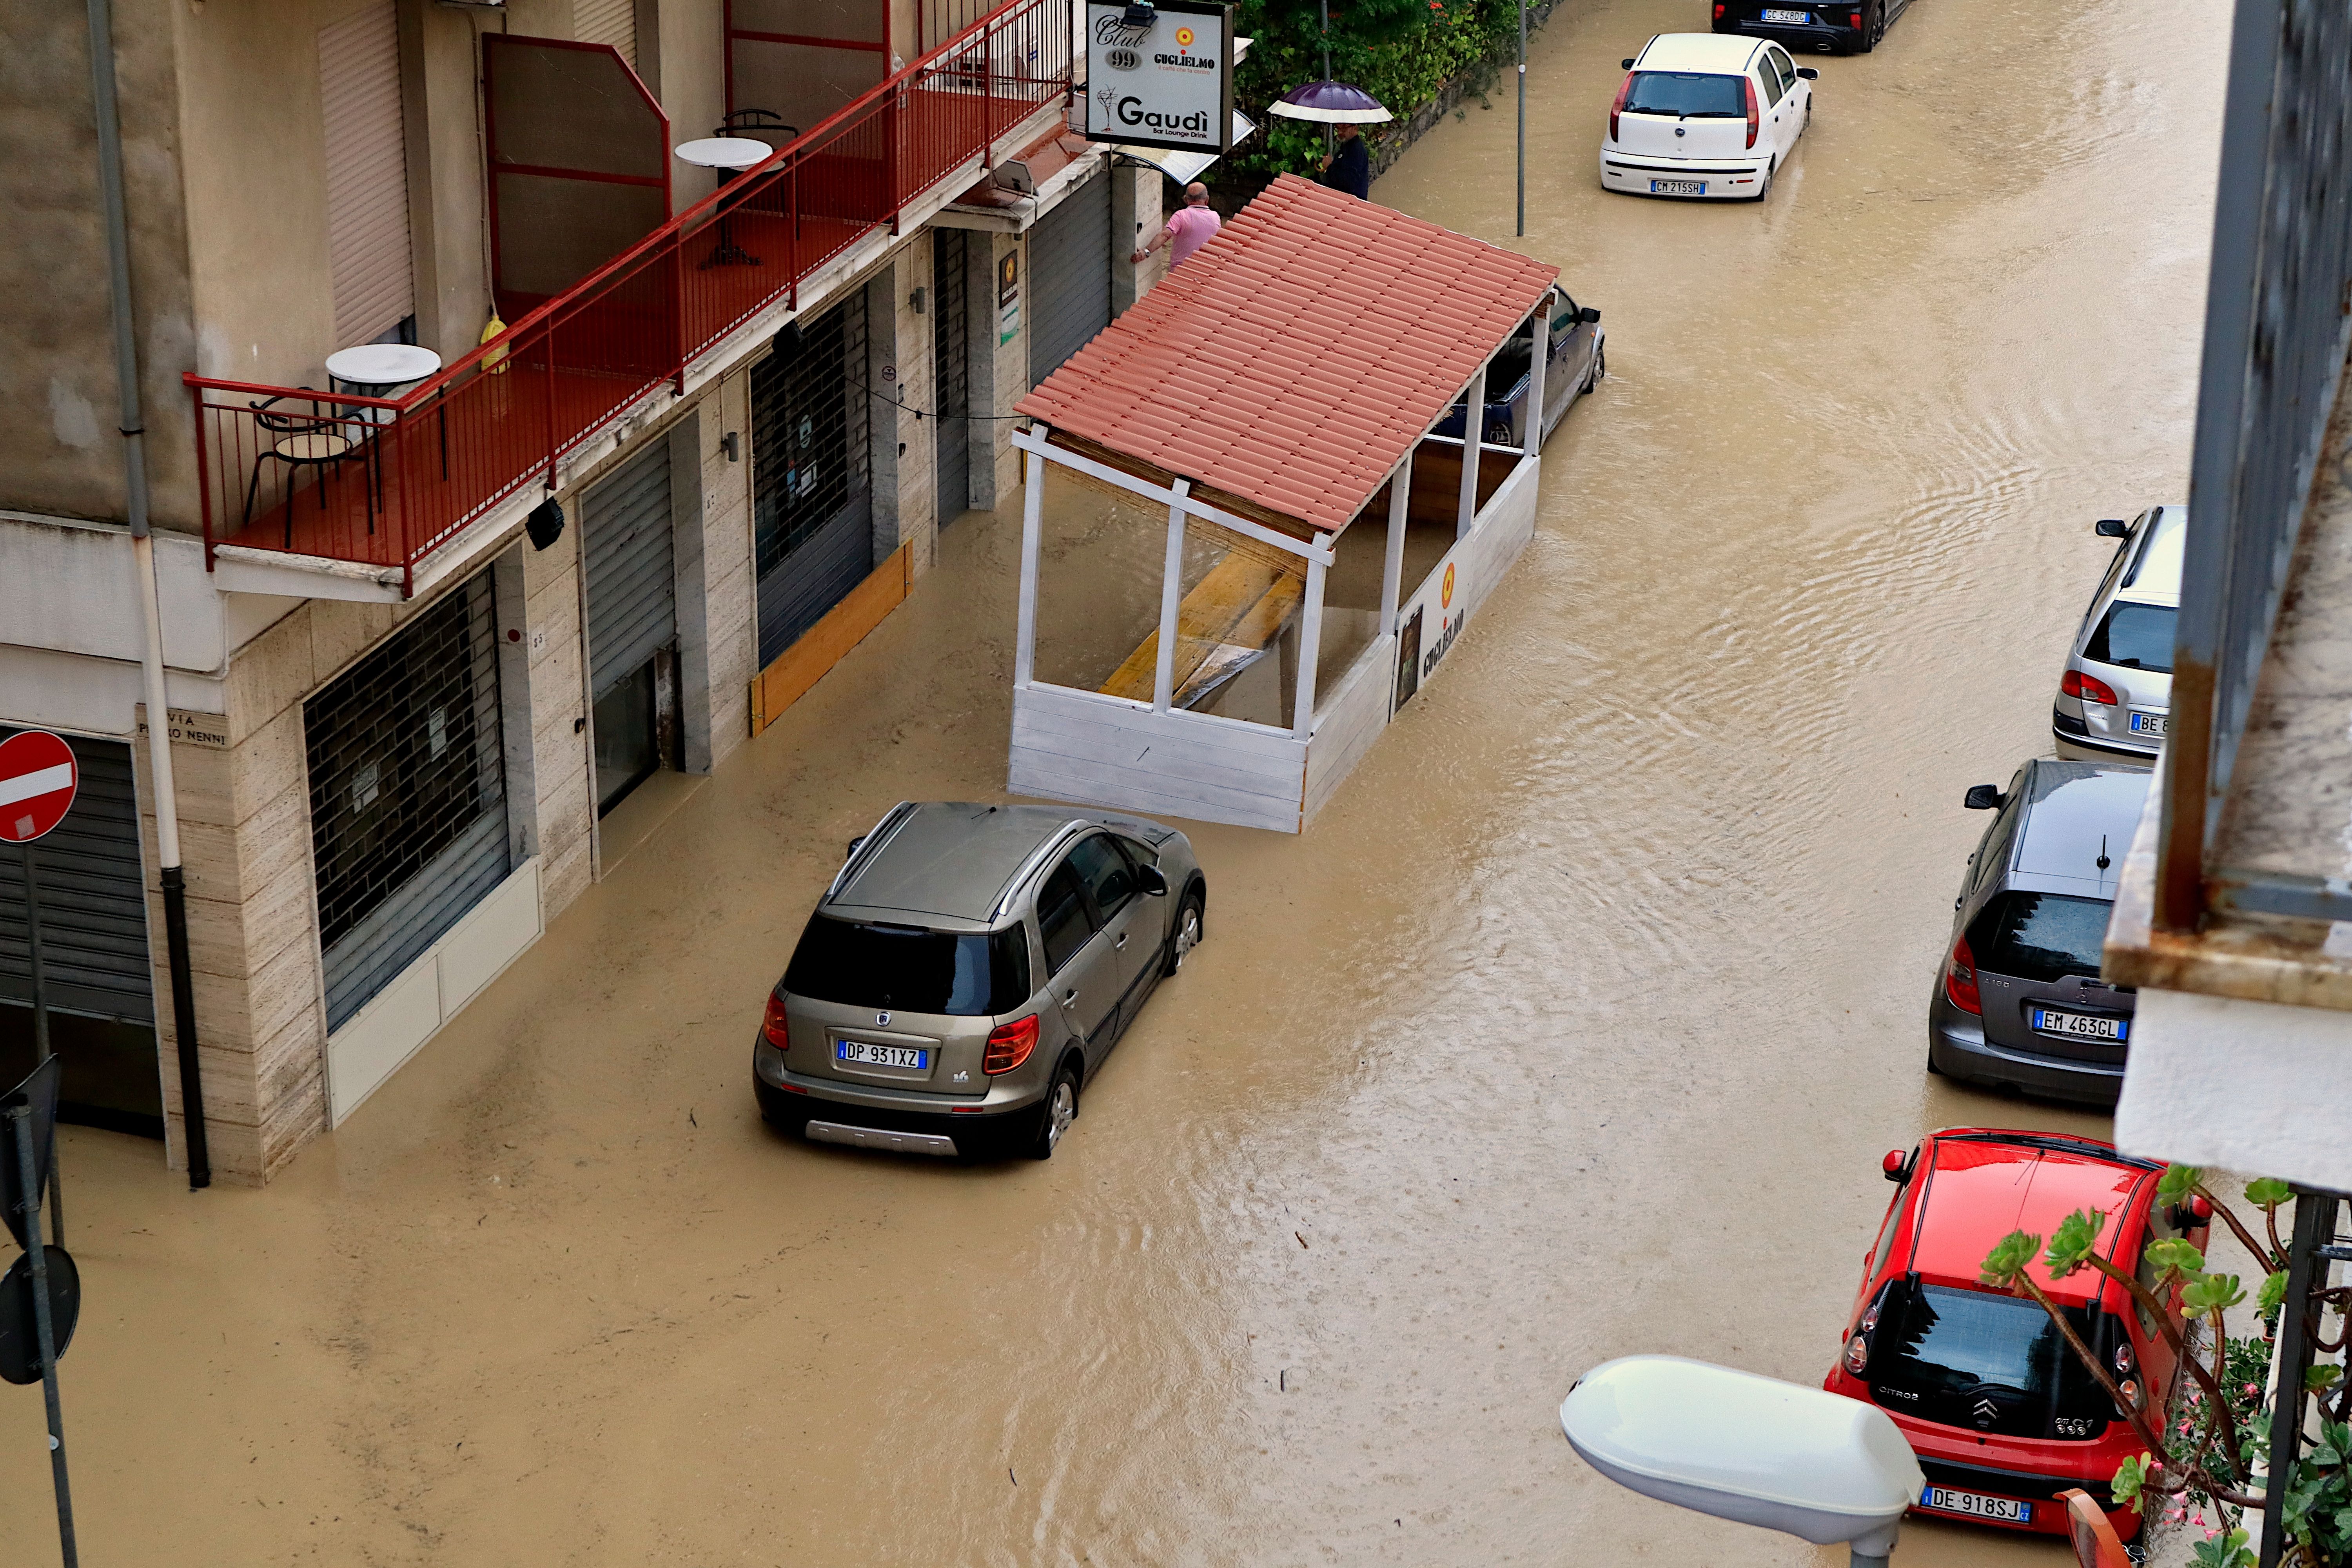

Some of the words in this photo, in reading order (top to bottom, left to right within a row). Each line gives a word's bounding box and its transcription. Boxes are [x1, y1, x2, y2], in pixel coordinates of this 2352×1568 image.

[1767, 10, 1777, 18] GC
[1780, 11, 1804, 20] 548DG
[1096, 15, 1152, 47] Club
[1112, 51, 1135, 68] 99
[1154, 54, 1215, 69] GUGLIELMO
[1118, 96, 1208, 132] Gaudì
[1657, 182, 1668, 191] CM
[1671, 182, 1699, 193] 215SH
[167, 713, 194, 726] VIA
[2141, 717, 2158, 731] BE
[187, 730, 225, 745] NENNI
[2044, 1013, 2063, 1030] EM
[2069, 1017, 2116, 1037] 463GL
[848, 1043, 864, 1059] DP
[871, 1047, 916, 1066] 931XZ
[1934, 1489, 1955, 1508] DE
[1962, 1494, 2018, 1517] 918SJ
